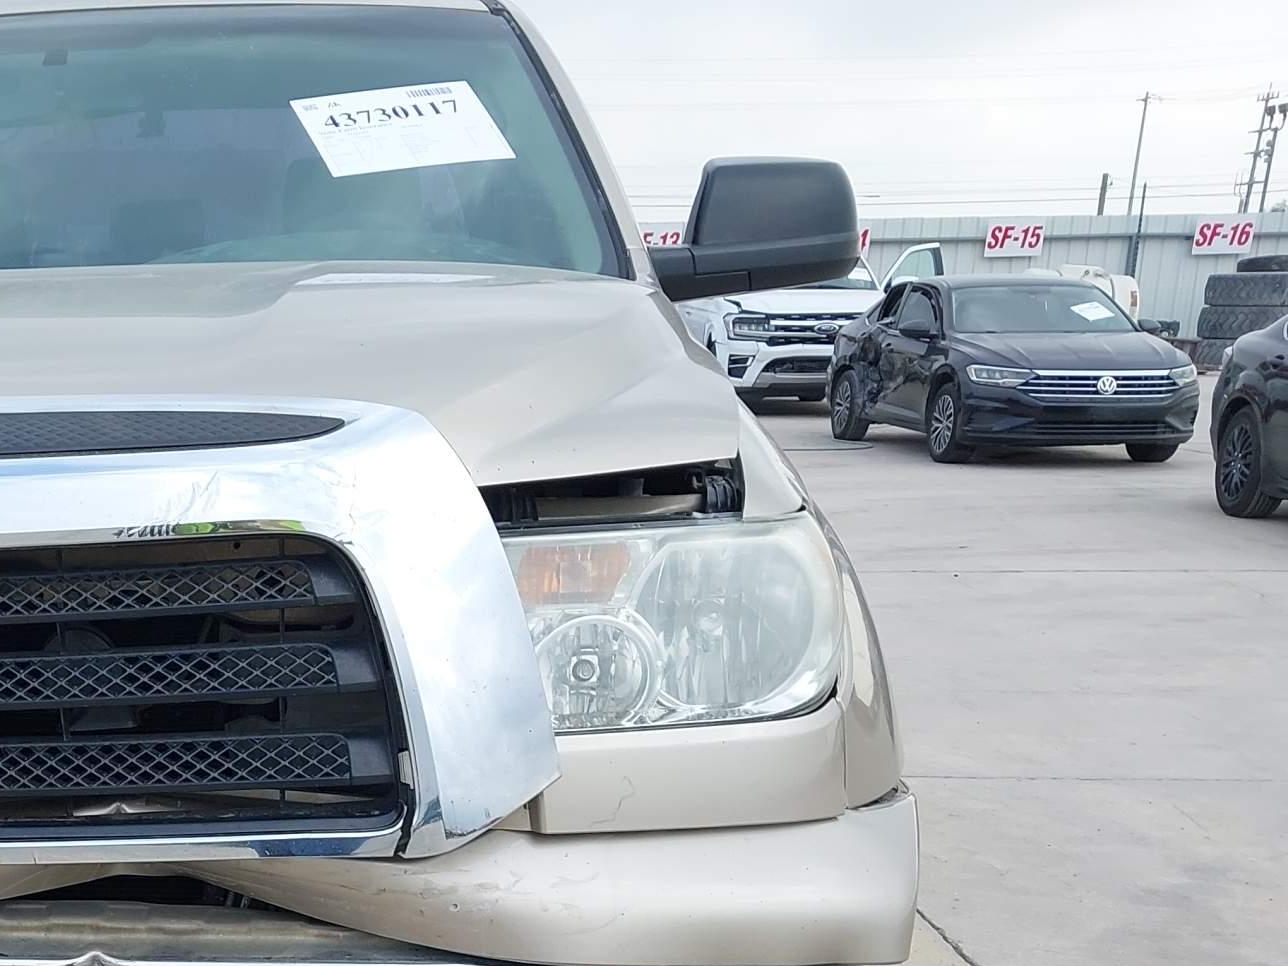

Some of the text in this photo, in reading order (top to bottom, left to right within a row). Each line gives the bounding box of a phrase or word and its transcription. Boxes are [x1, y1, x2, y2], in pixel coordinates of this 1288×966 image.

[323, 99, 458, 129] 43730117
[987, 225, 1044, 250] SF-15
[1195, 222, 1253, 247] SF-16
